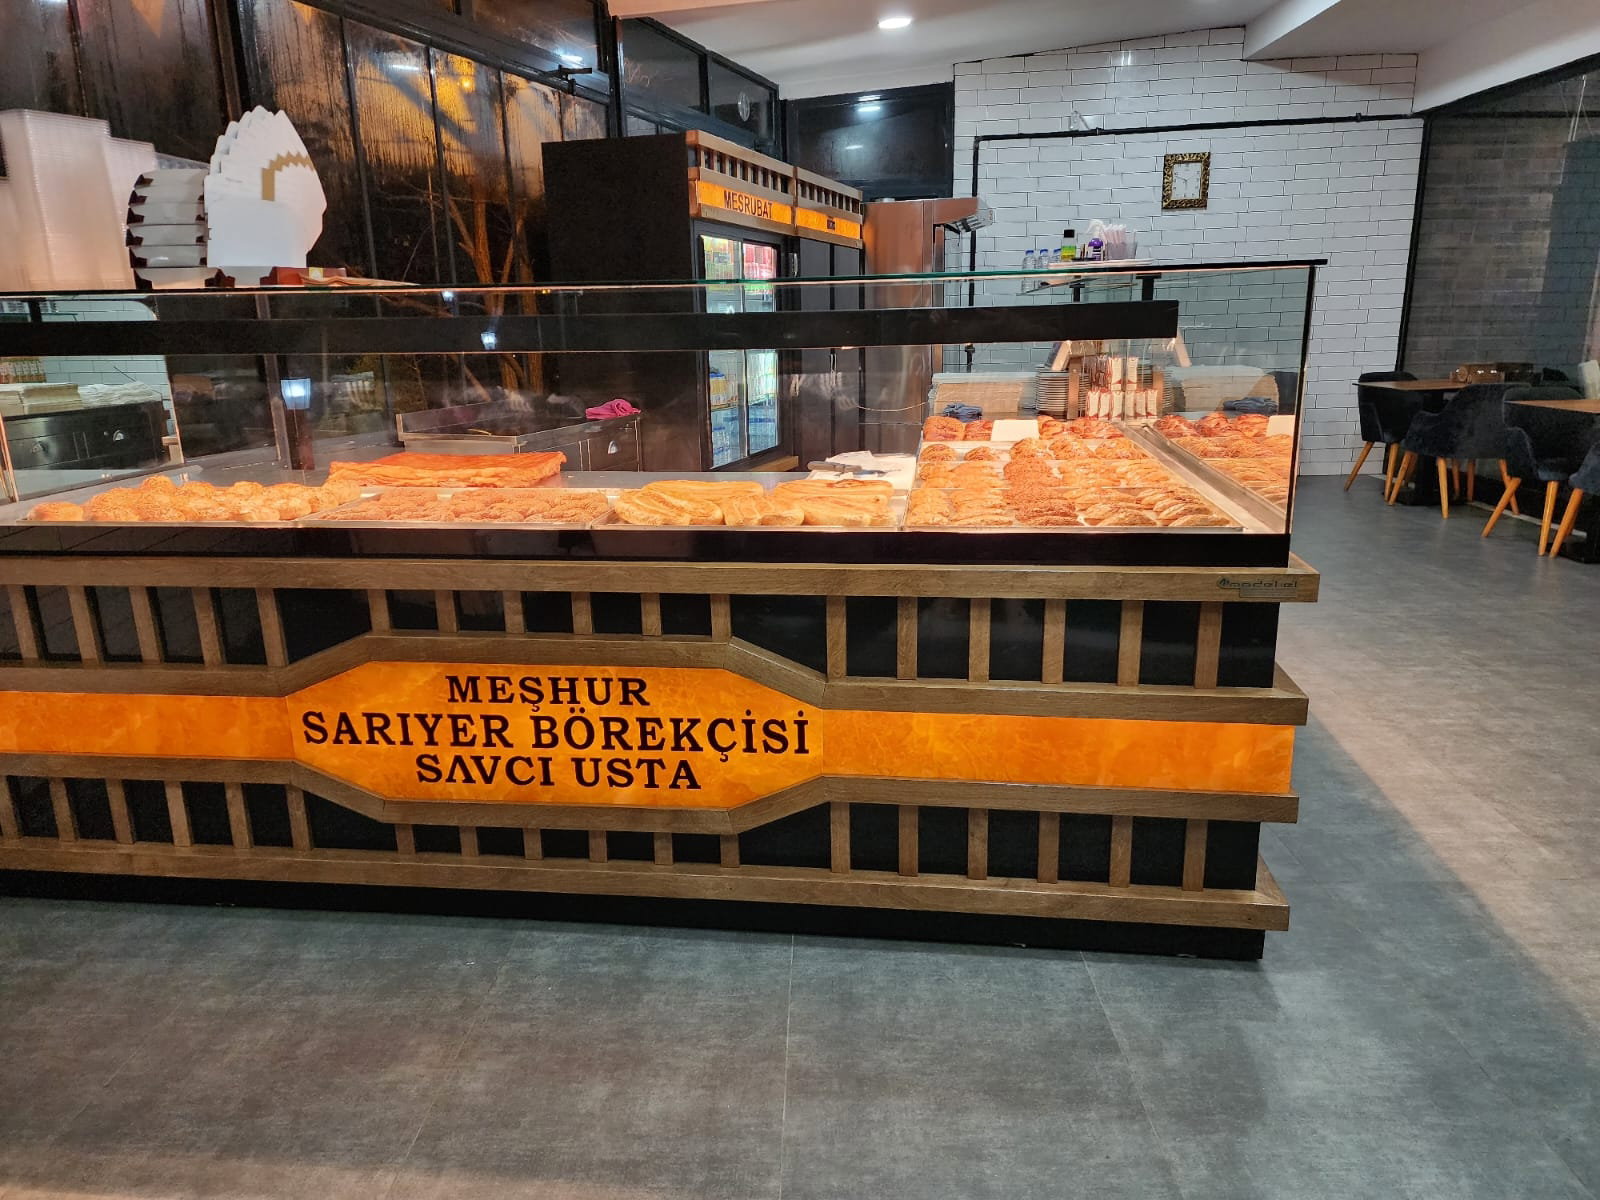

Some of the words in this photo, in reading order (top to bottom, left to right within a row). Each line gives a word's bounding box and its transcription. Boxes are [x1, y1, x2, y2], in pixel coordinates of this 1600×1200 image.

[446, 675, 650, 712] MEŞHUR
[303, 711, 514, 748] SARIYER
[530, 707, 809, 762] BÖREKÇİSİ
[415, 754, 553, 787] SAVCI
[571, 757, 702, 790] USTA
